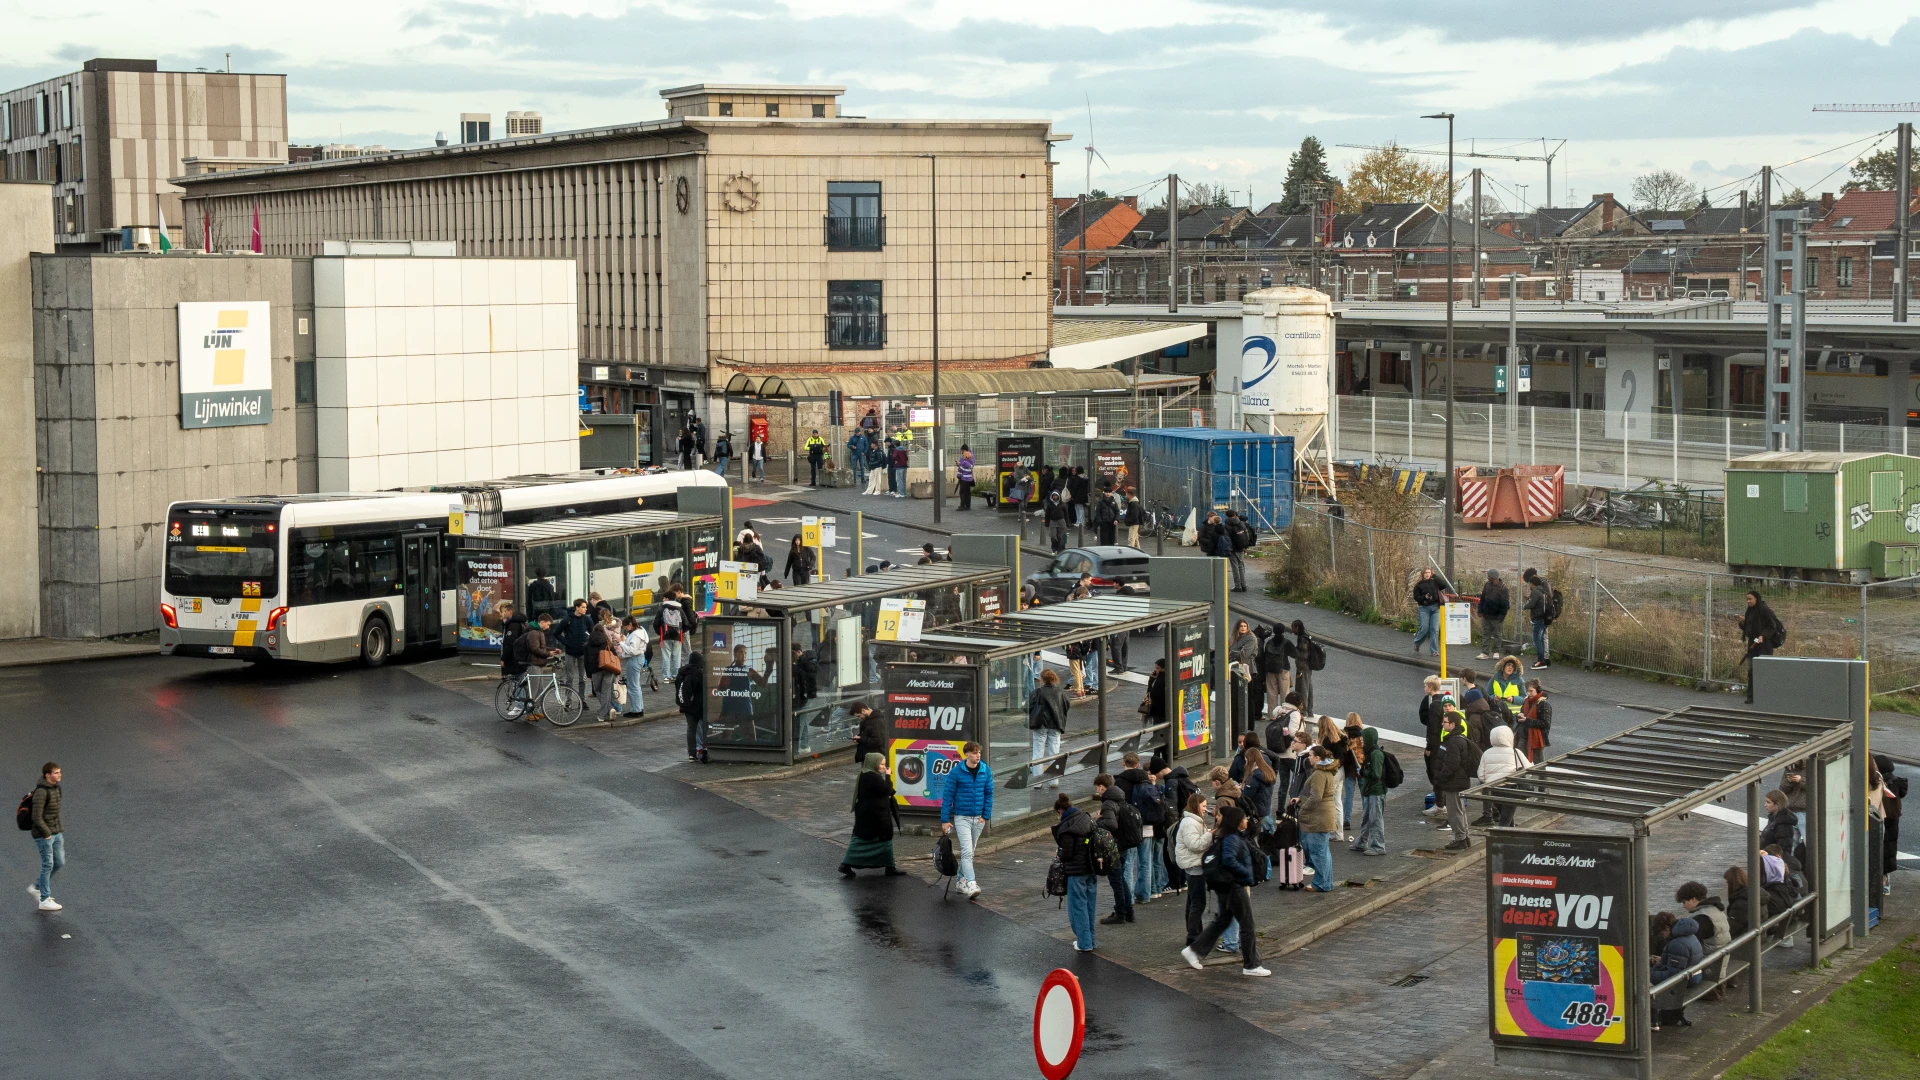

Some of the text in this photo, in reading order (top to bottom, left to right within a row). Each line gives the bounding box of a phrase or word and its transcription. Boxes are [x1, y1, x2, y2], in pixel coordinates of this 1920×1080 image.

[203, 335, 232, 349] LIJN
[194, 395, 262, 424] Lijnwinkel
[454, 519, 460, 527] 9
[805, 531, 815, 540] 10
[468, 560, 487, 569] Voor
[705, 552, 718, 569] YO!
[478, 570, 508, 578] cadeau
[470, 576, 480, 584] dat
[725, 580, 734, 591] 11
[883, 620, 896, 631] 12
[1192, 654, 1205, 677] YO!
[712, 689, 761, 699] Geef nooit op
[894, 707, 927, 717] De beste
[895, 717, 930, 729] deals?
[928, 706, 966, 731] YO!
[1517, 878, 1533, 886] Friday
[1502, 893, 1552, 908] De beste
[1503, 907, 1557, 927] deals?
[1555, 893, 1614, 930] YO!
[1505, 987, 1523, 995] TCL
